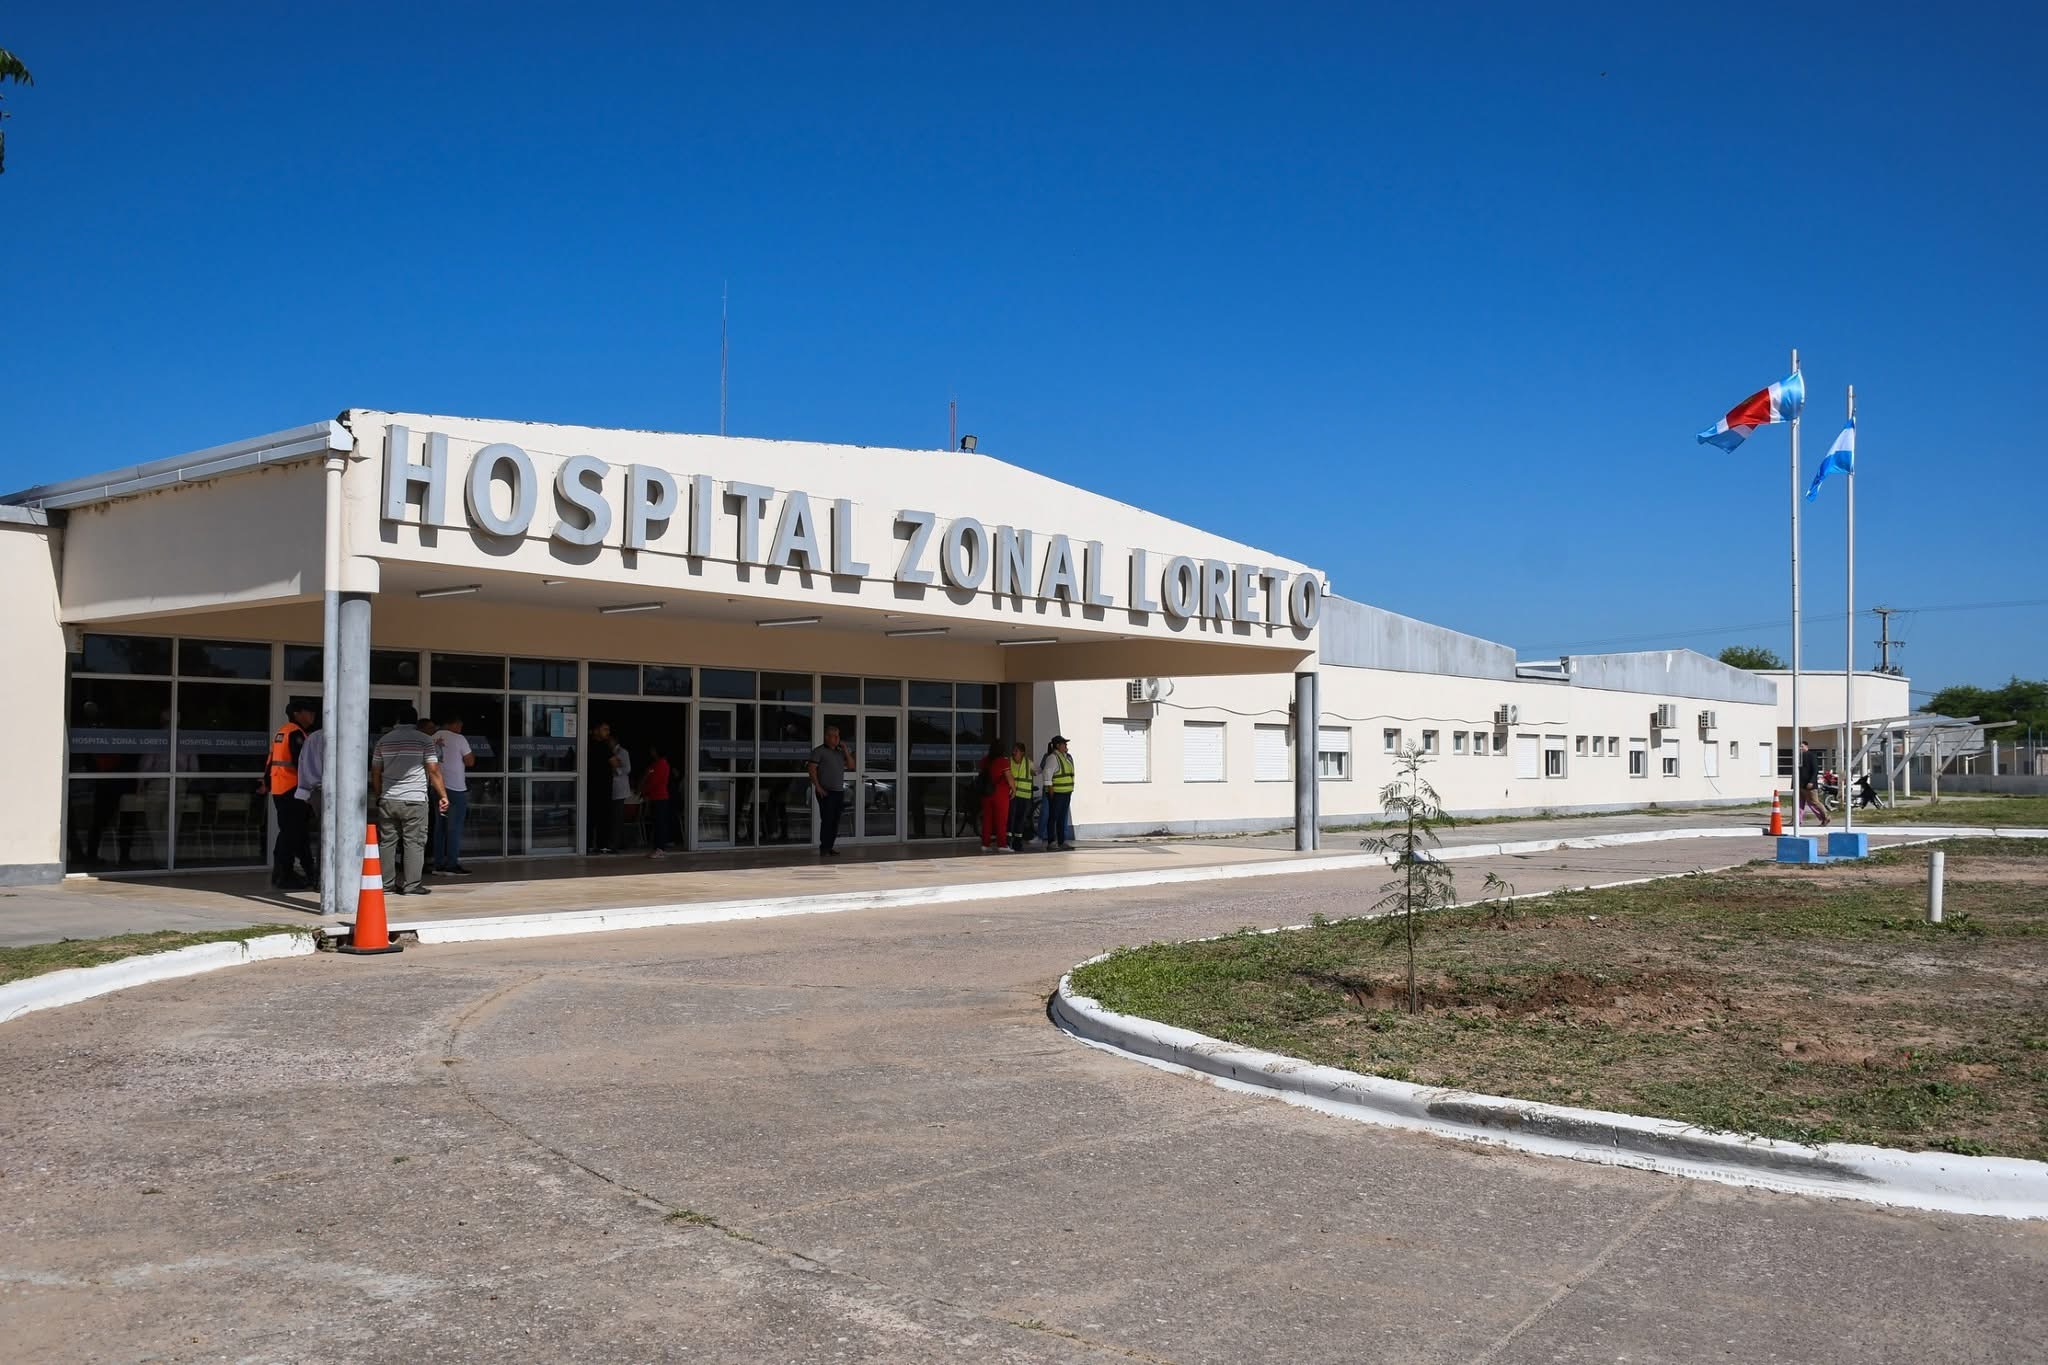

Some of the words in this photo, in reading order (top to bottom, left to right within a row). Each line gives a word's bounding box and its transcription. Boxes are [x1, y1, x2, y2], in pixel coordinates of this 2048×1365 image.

[382, 424, 869, 576] HOSPITAL
[895, 509, 1114, 607] ZONAL
[1130, 547, 1321, 630] LORETO
[71, 737, 109, 745] HOSPITAL
[112, 737, 137, 745] ZONAL
